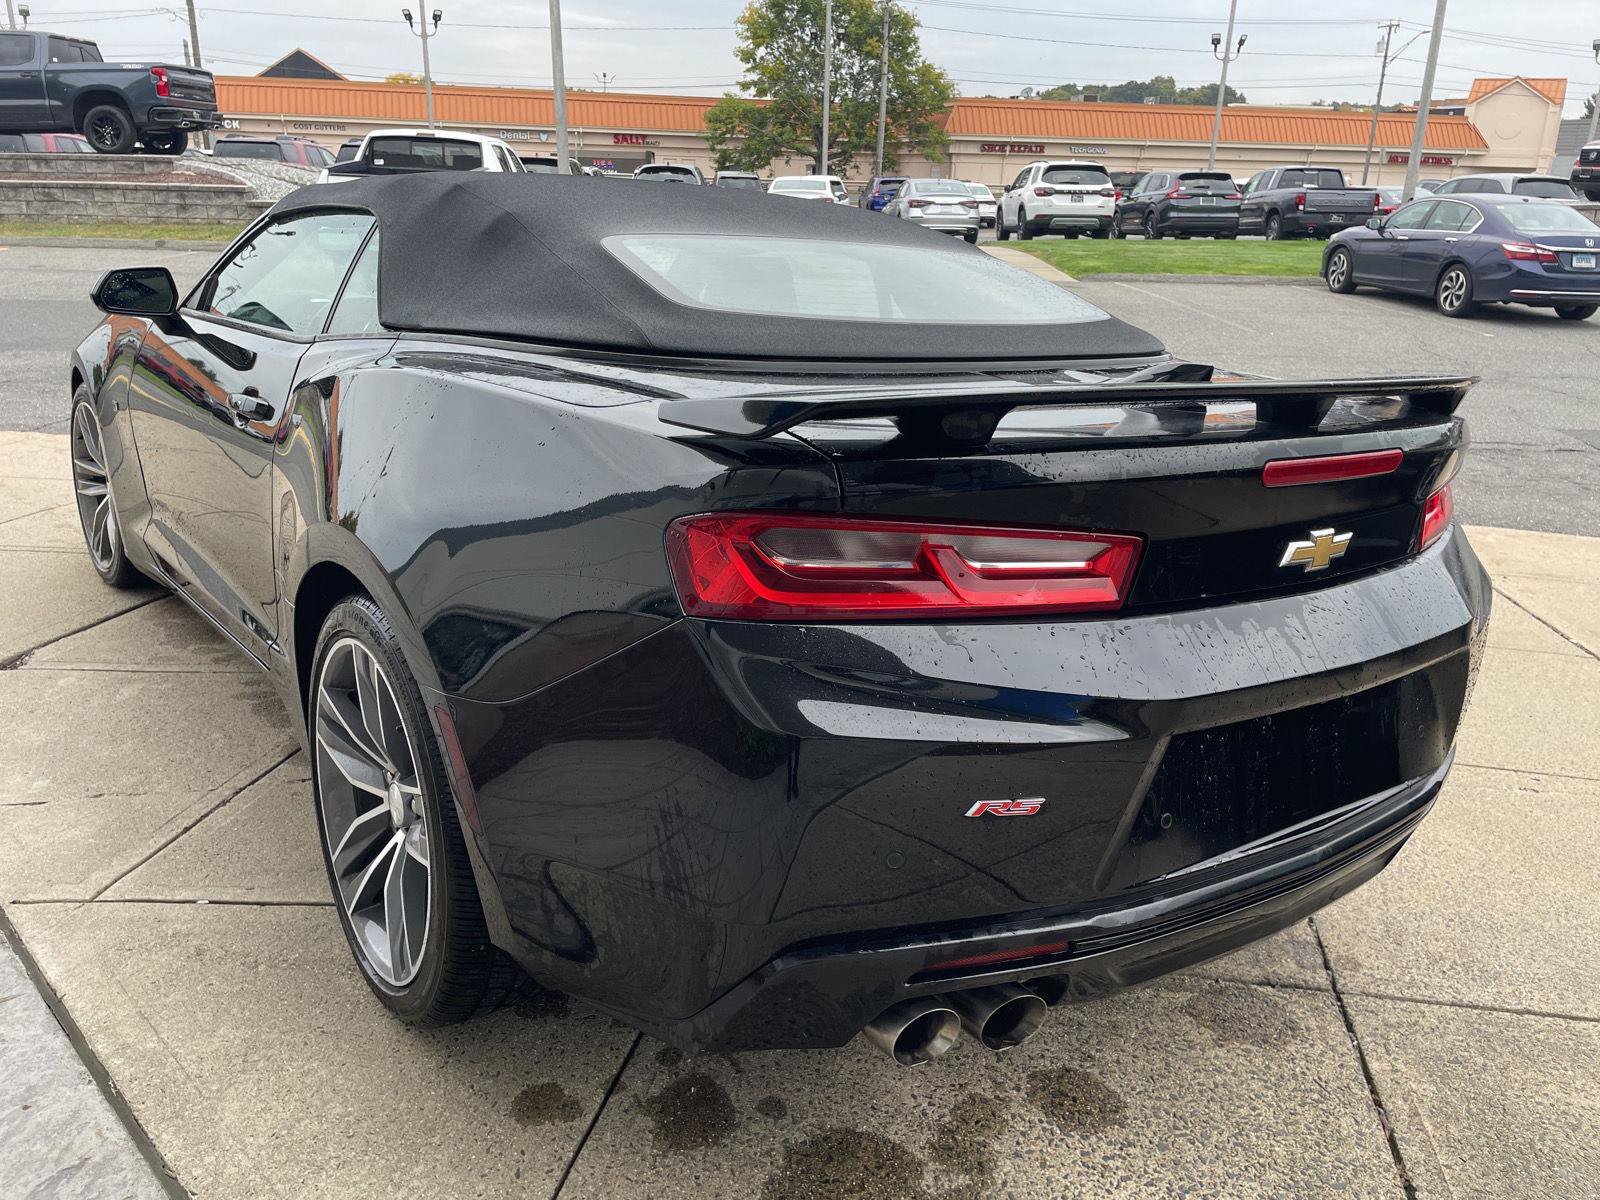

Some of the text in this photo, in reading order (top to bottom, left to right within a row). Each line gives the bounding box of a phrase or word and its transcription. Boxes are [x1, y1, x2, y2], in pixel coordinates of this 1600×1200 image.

[314, 124, 346, 132] CUTTERS
[500, 130, 530, 140] Dental
[613, 134, 646, 145] SALLY
[980, 144, 1045, 154] SHOE REPAIR
[964, 797, 1046, 817] RS
